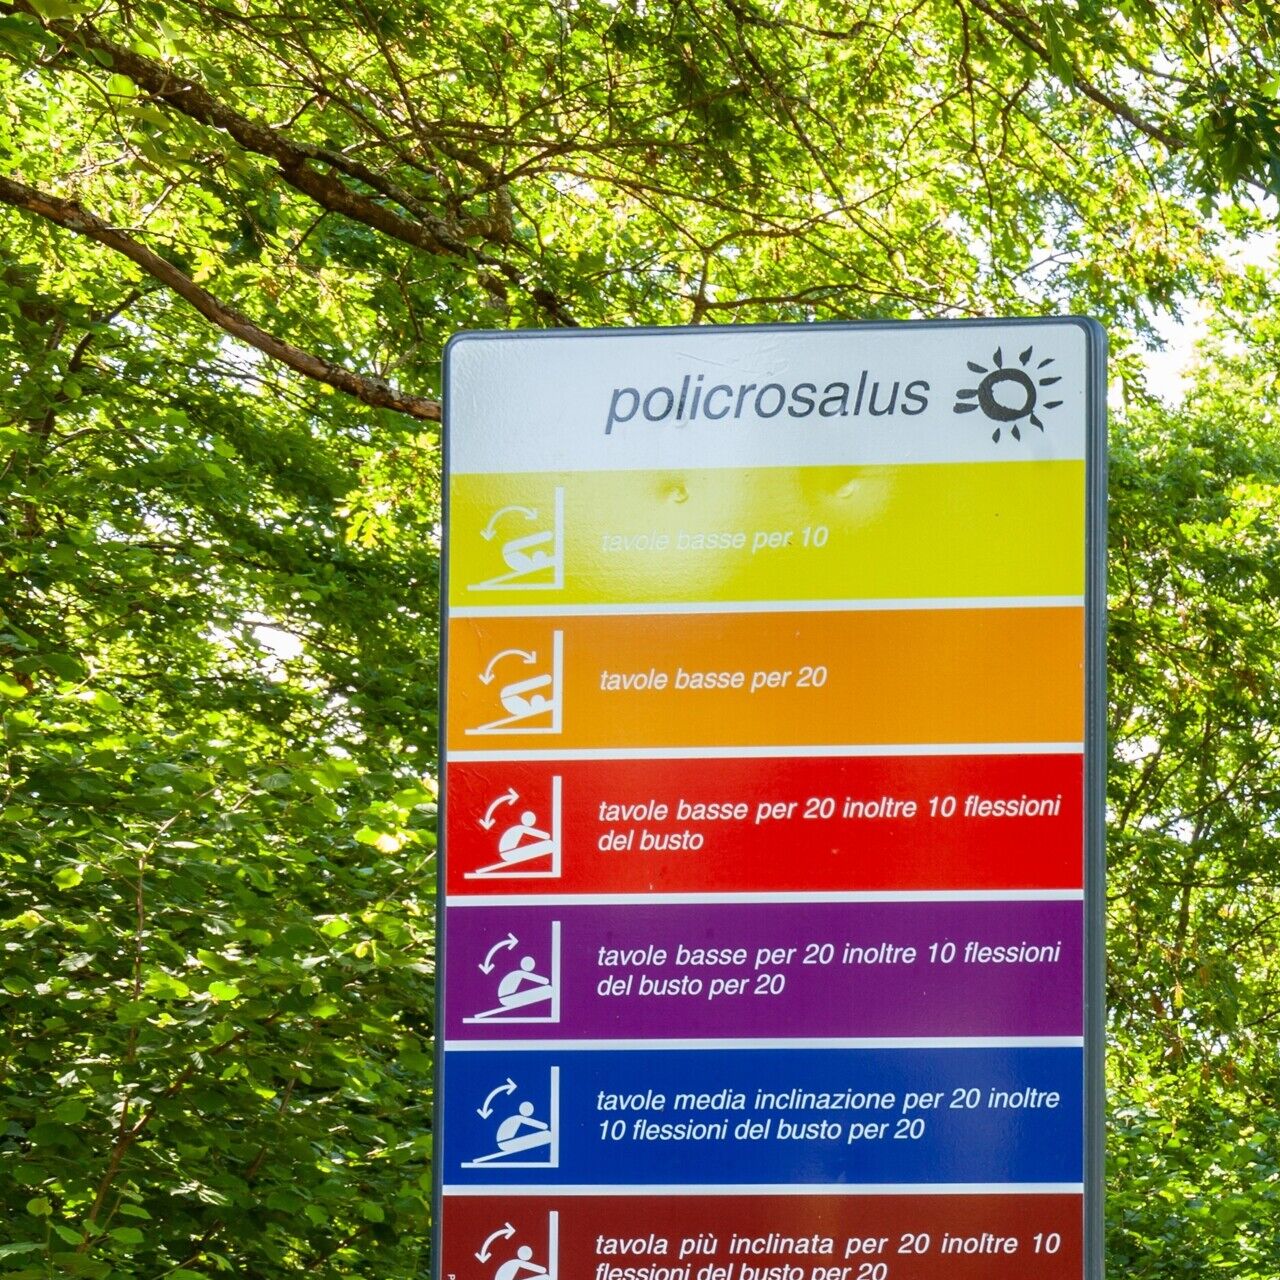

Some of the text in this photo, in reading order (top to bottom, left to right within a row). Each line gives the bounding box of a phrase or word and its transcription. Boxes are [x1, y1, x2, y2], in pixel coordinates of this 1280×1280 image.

[605, 370, 931, 435] policrosalus
[600, 526, 829, 554] tavole basse per 10
[599, 665, 828, 693] tavole basse per 20
[598, 794, 1062, 825] tavole basse per 20 inoltre 10 flessioni
[597, 829, 704, 852] del busto
[597, 941, 1062, 970] tavole basse per 20 inoltre 10 flessioni
[597, 973, 786, 1001] del busto per 20
[596, 1087, 1060, 1115] tavole media inclinazione per 20 inoltre
[599, 1118, 926, 1145] 10 flessioni del busto per 20
[595, 1232, 1061, 1260] tavola più inclinata per 20 inoltre 10
